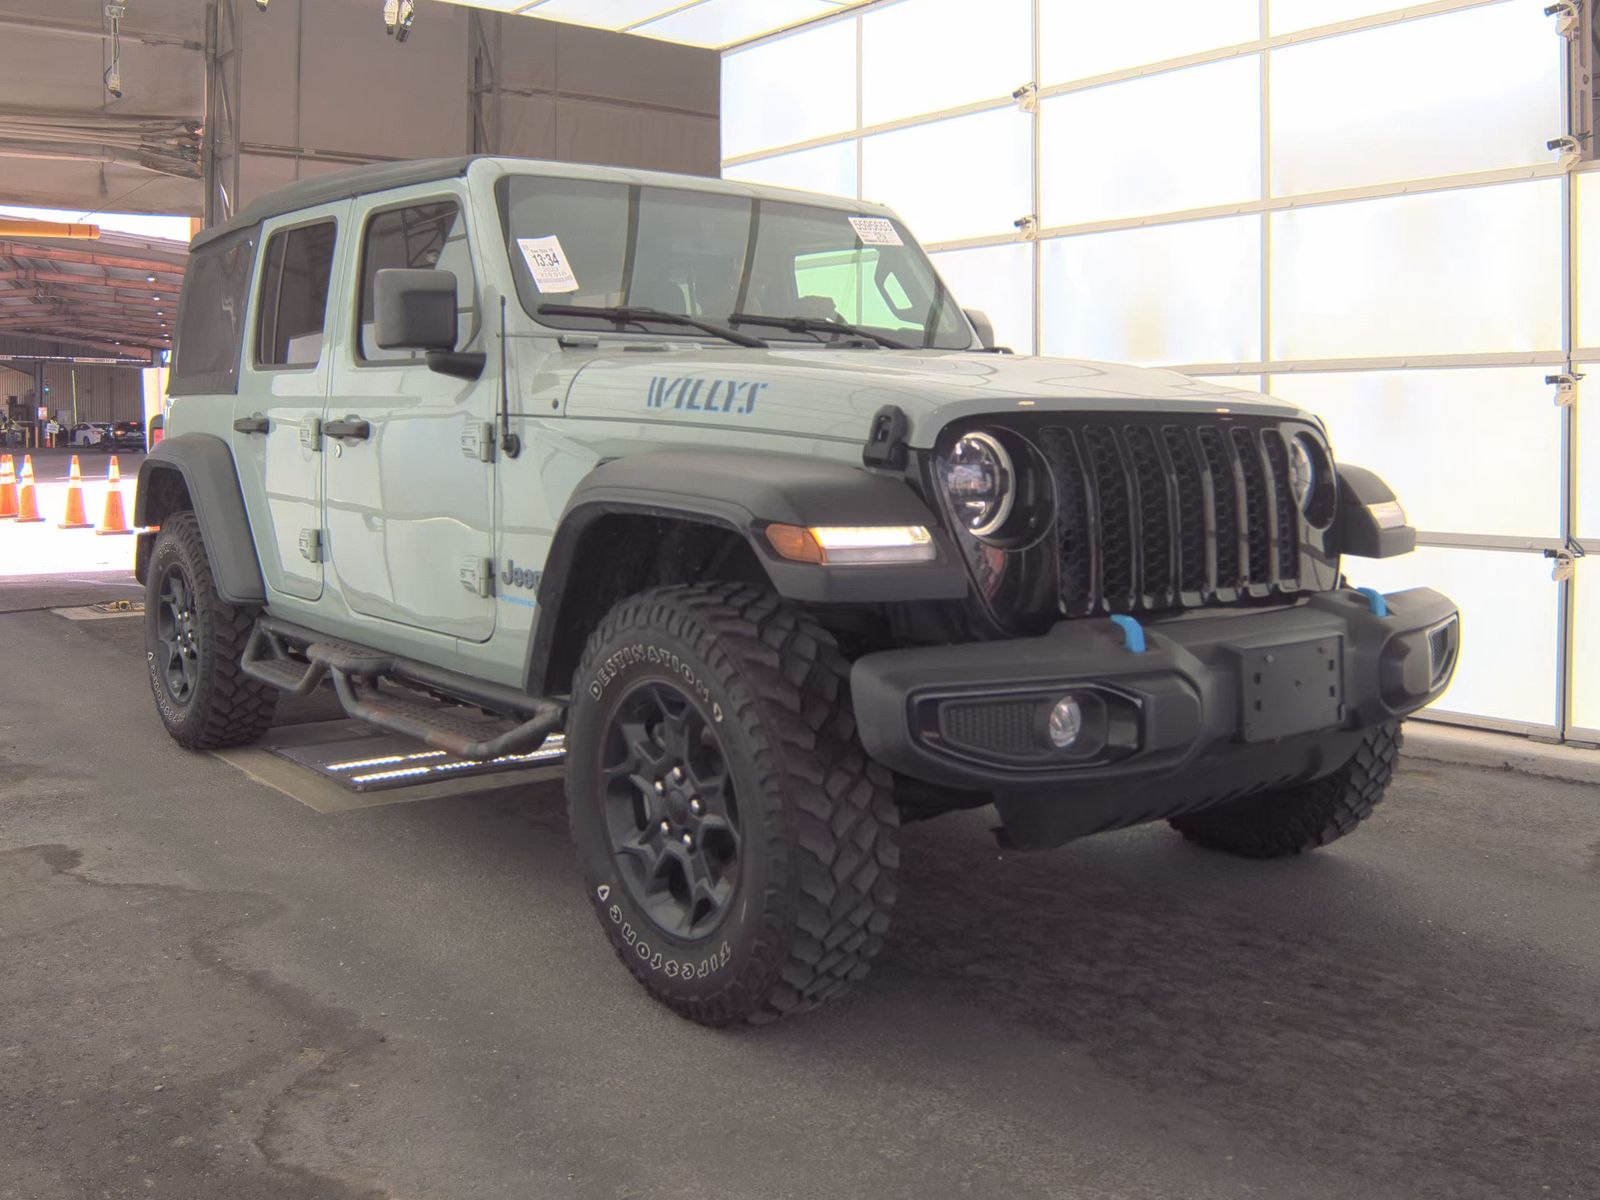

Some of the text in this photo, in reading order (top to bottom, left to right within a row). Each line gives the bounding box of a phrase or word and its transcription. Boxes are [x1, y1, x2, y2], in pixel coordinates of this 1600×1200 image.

[532, 252, 560, 267] 13:34
[646, 376, 769, 414] WILLYS
[609, 904, 731, 980] Firestone
